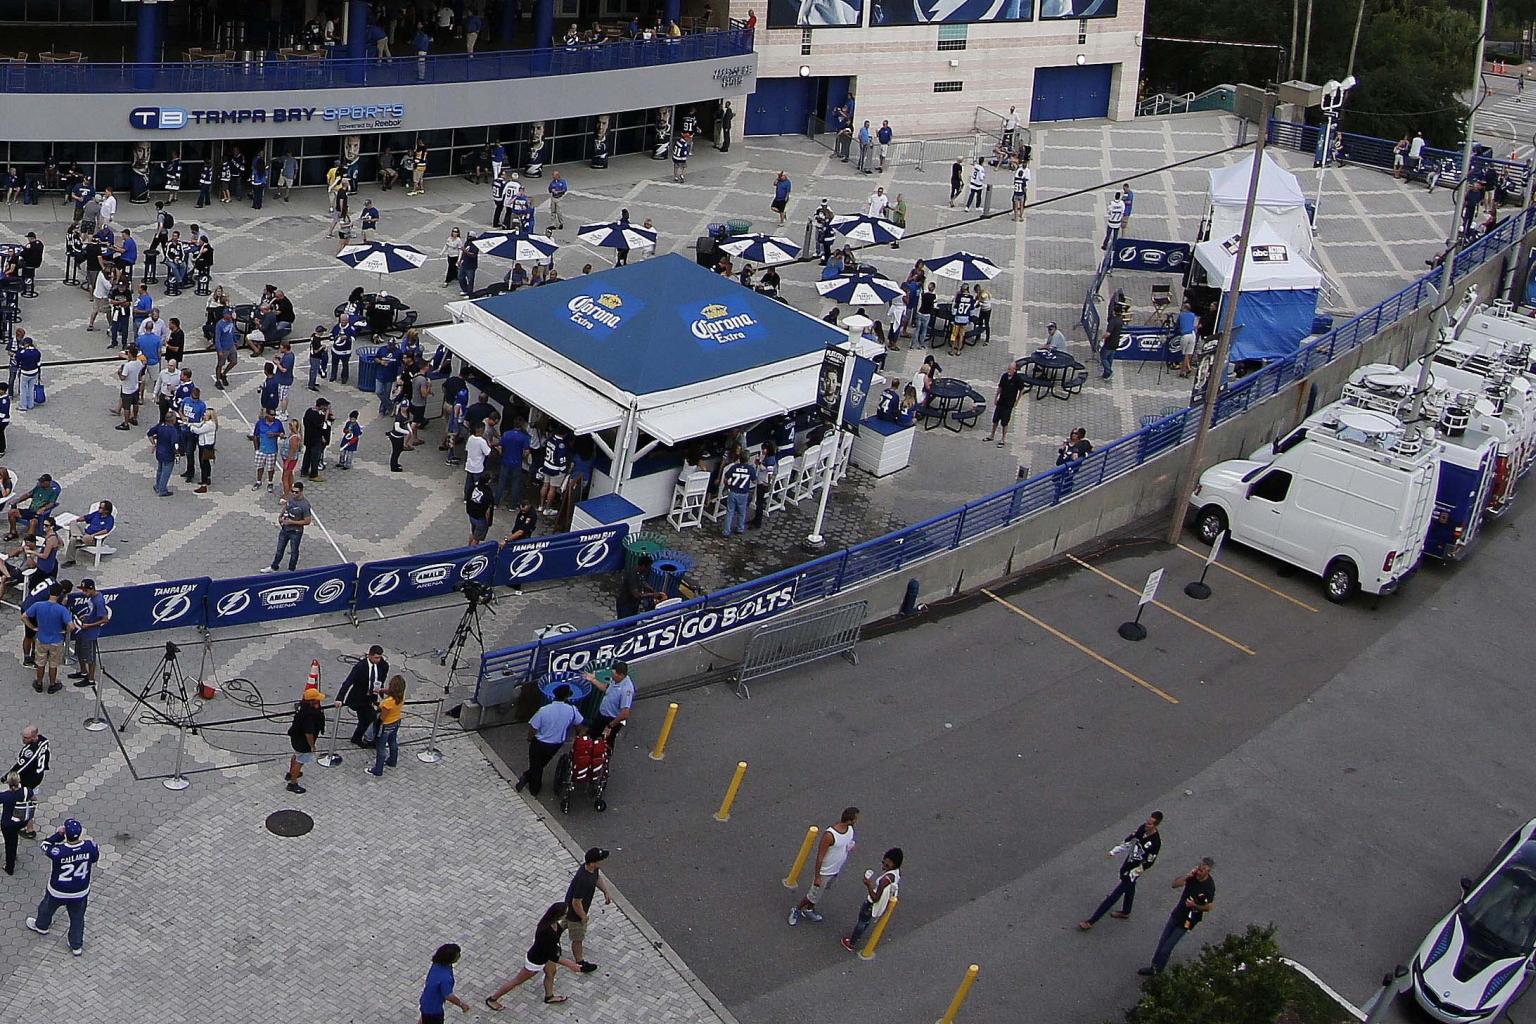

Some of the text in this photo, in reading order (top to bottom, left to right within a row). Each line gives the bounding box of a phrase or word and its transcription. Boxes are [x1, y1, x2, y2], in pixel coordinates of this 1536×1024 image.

[134, 104, 404, 126] TB TAMPA BAY SPORTS
[375, 118, 402, 127] Reebok
[1253, 247, 1268, 257] abc
[568, 295, 622, 328] Corona
[958, 303, 970, 314] 87
[571, 312, 594, 330] Extra
[691, 313, 754, 339] Corona
[716, 332, 746, 344] Extra
[732, 473, 750, 488] 77
[154, 584, 198, 597] TAMPA BAY
[268, 592, 299, 604] AMALIE
[267, 602, 296, 610] ARENA
[682, 586, 793, 639] GO BOLTS
[552, 625, 676, 675] GO BOLTS
[36, 754, 45, 773] 9
[58, 861, 89, 881] 24
